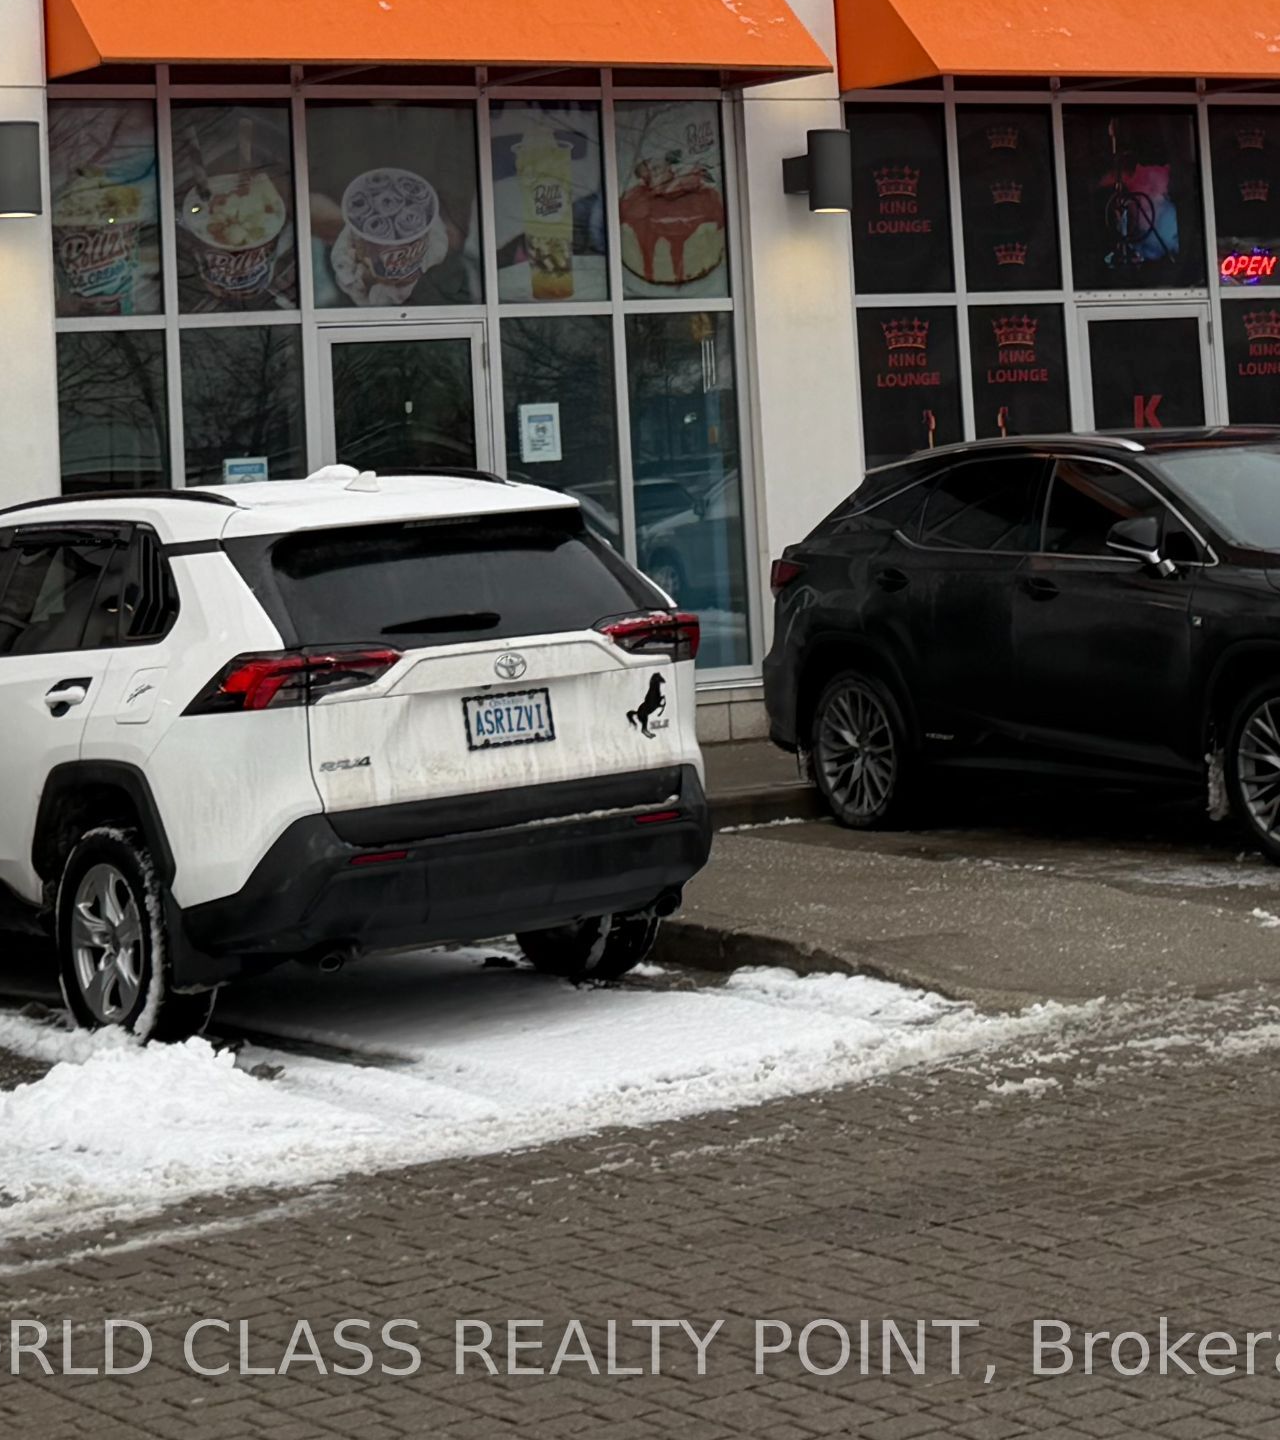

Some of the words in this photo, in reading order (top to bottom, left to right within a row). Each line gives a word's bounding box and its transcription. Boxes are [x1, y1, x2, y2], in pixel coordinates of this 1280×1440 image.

[880, 201, 918, 214] KING
[868, 220, 932, 234] LOUNGE
[1221, 255, 1276, 277] OPEN
[888, 352, 927, 367] KING
[998, 349, 1036, 364] KING
[877, 372, 940, 387] LOUNGE
[987, 368, 1049, 383] LOUNGE
[1133, 394, 1165, 428] K
[476, 704, 544, 736] ASRIZVI
[319, 756, 371, 772] RAV4
